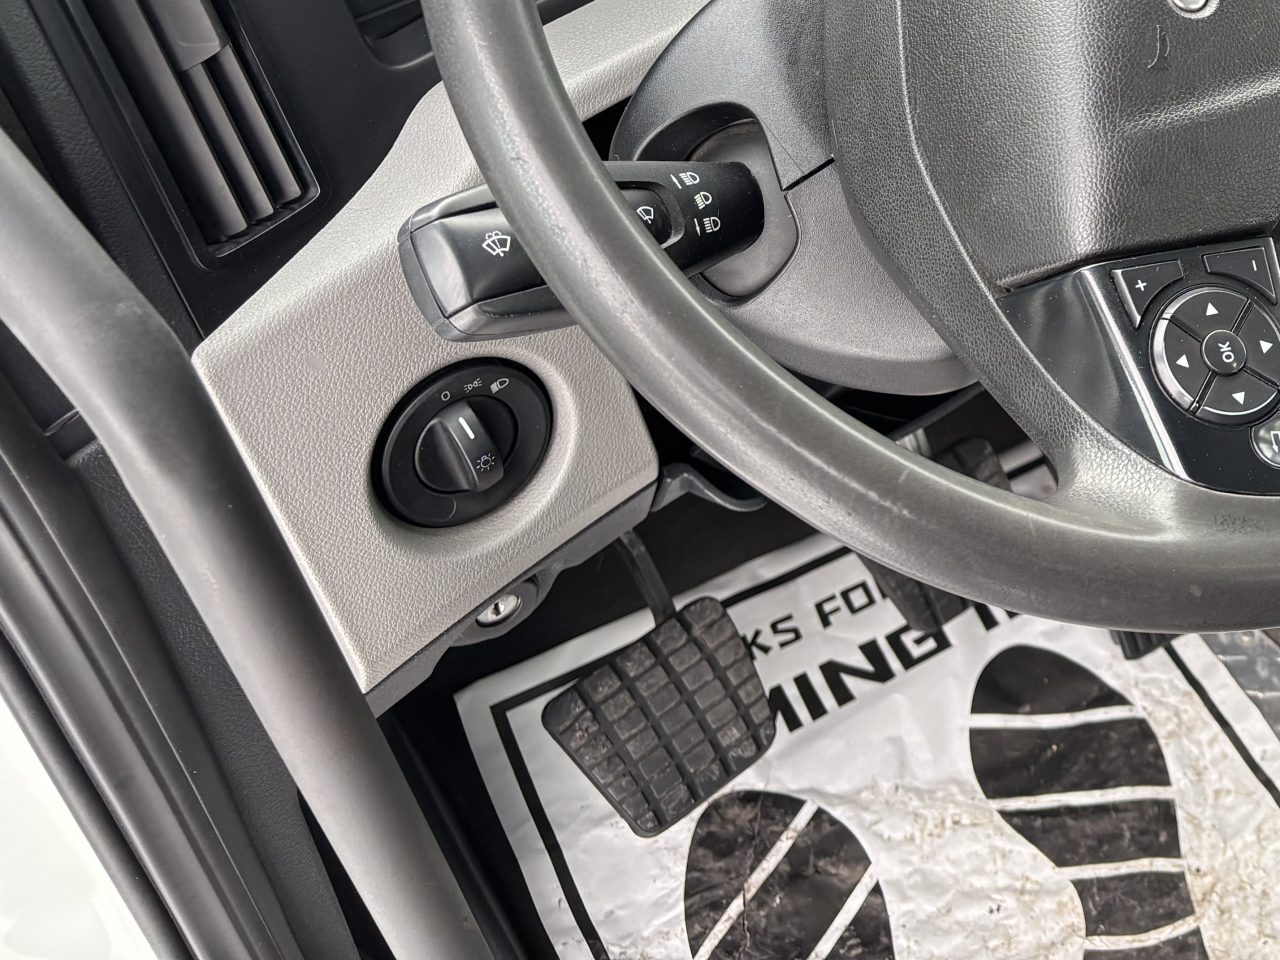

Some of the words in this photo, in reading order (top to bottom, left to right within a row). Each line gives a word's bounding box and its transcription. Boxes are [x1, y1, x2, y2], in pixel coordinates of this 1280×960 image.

[1218, 340, 1235, 363] OK
[742, 613, 803, 661] KS
[814, 581, 886, 631] FO
